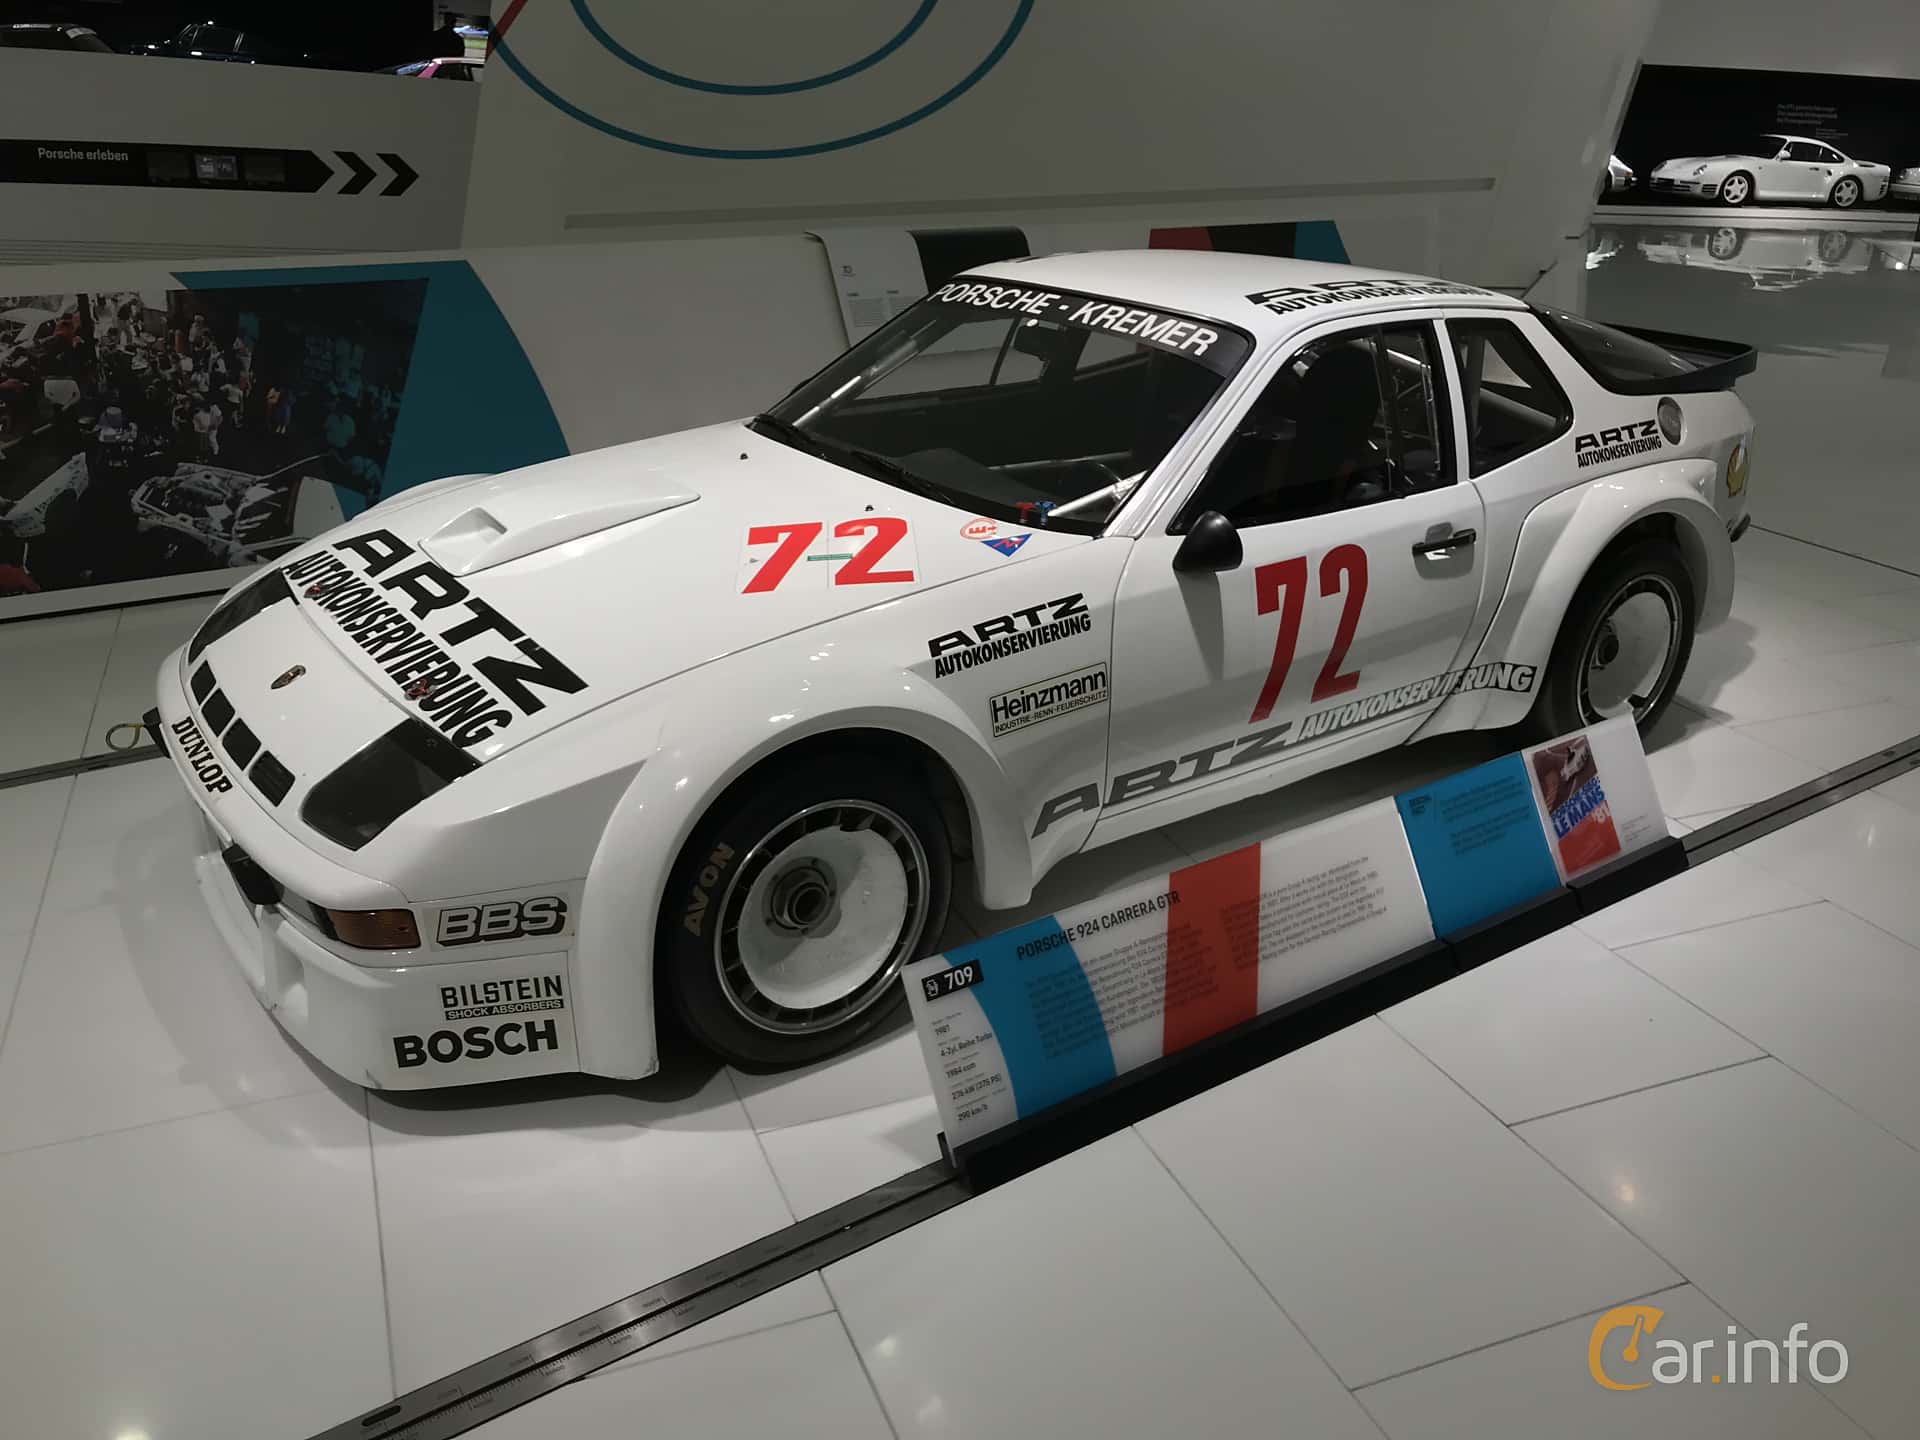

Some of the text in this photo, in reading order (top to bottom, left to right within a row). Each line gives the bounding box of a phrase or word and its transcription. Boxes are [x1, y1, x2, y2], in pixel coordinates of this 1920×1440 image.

[37, 147, 129, 162] Porsche erleben
[927, 283, 1061, 314] PORSCHE
[1068, 301, 1219, 356] KREMER
[1575, 419, 1658, 452] ARTZ
[1577, 435, 1662, 468] AUTOKONSERVIERUNG
[741, 517, 914, 594] 72
[280, 550, 513, 748] AUTOKONSERVIERUNG
[331, 528, 590, 716] ARTZ
[928, 593, 1089, 657] ARTZ
[935, 613, 1092, 678] AUTOKONSERVIERUNG
[1248, 544, 1368, 724] 72
[991, 670, 1107, 723] Heinzmann
[171, 715, 233, 793] DUNLOP
[1032, 663, 1536, 838] ARTZ AUTOKONSERVIERUNG
[1567, 786, 1606, 828] MANS
[436, 896, 568, 946] BBS
[683, 842, 735, 937] AVON
[1015, 890, 1181, 961] PORSCHE 924 CARRERA GTR
[440, 975, 563, 1008] BILSTEIN
[447, 999, 562, 1020] SHOCK ABSORBERS
[943, 965, 973, 990] 709
[393, 1019, 559, 1068] BOSCH
